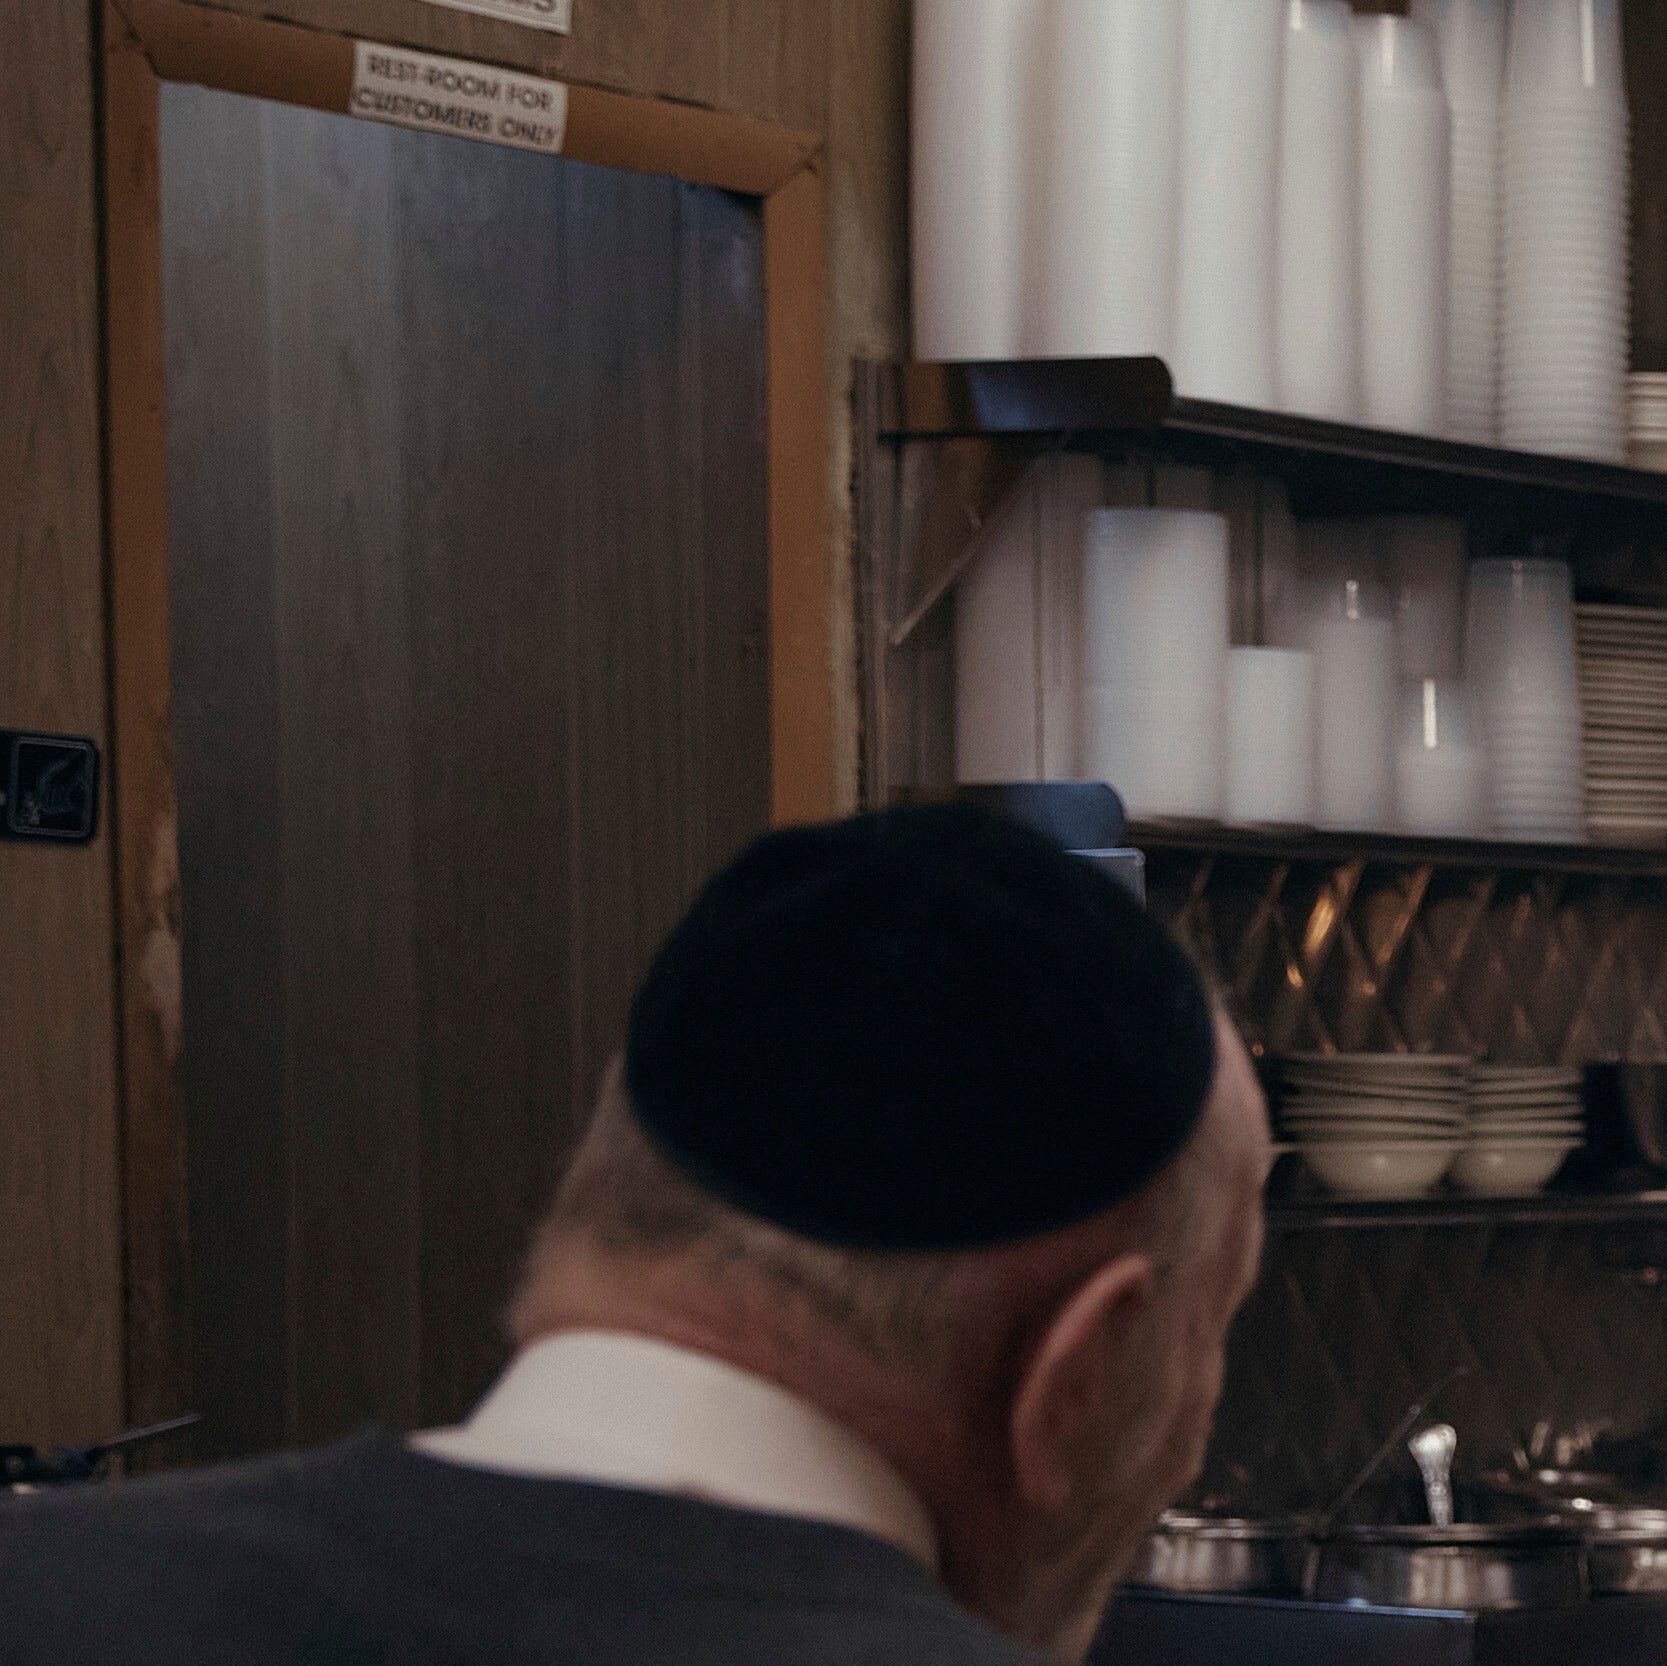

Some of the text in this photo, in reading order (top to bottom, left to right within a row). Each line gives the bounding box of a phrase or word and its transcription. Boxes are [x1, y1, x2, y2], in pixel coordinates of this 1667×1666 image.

[353, 87, 558, 143] CUSTOMERS ONLY
[506, 82, 553, 111] FOR
